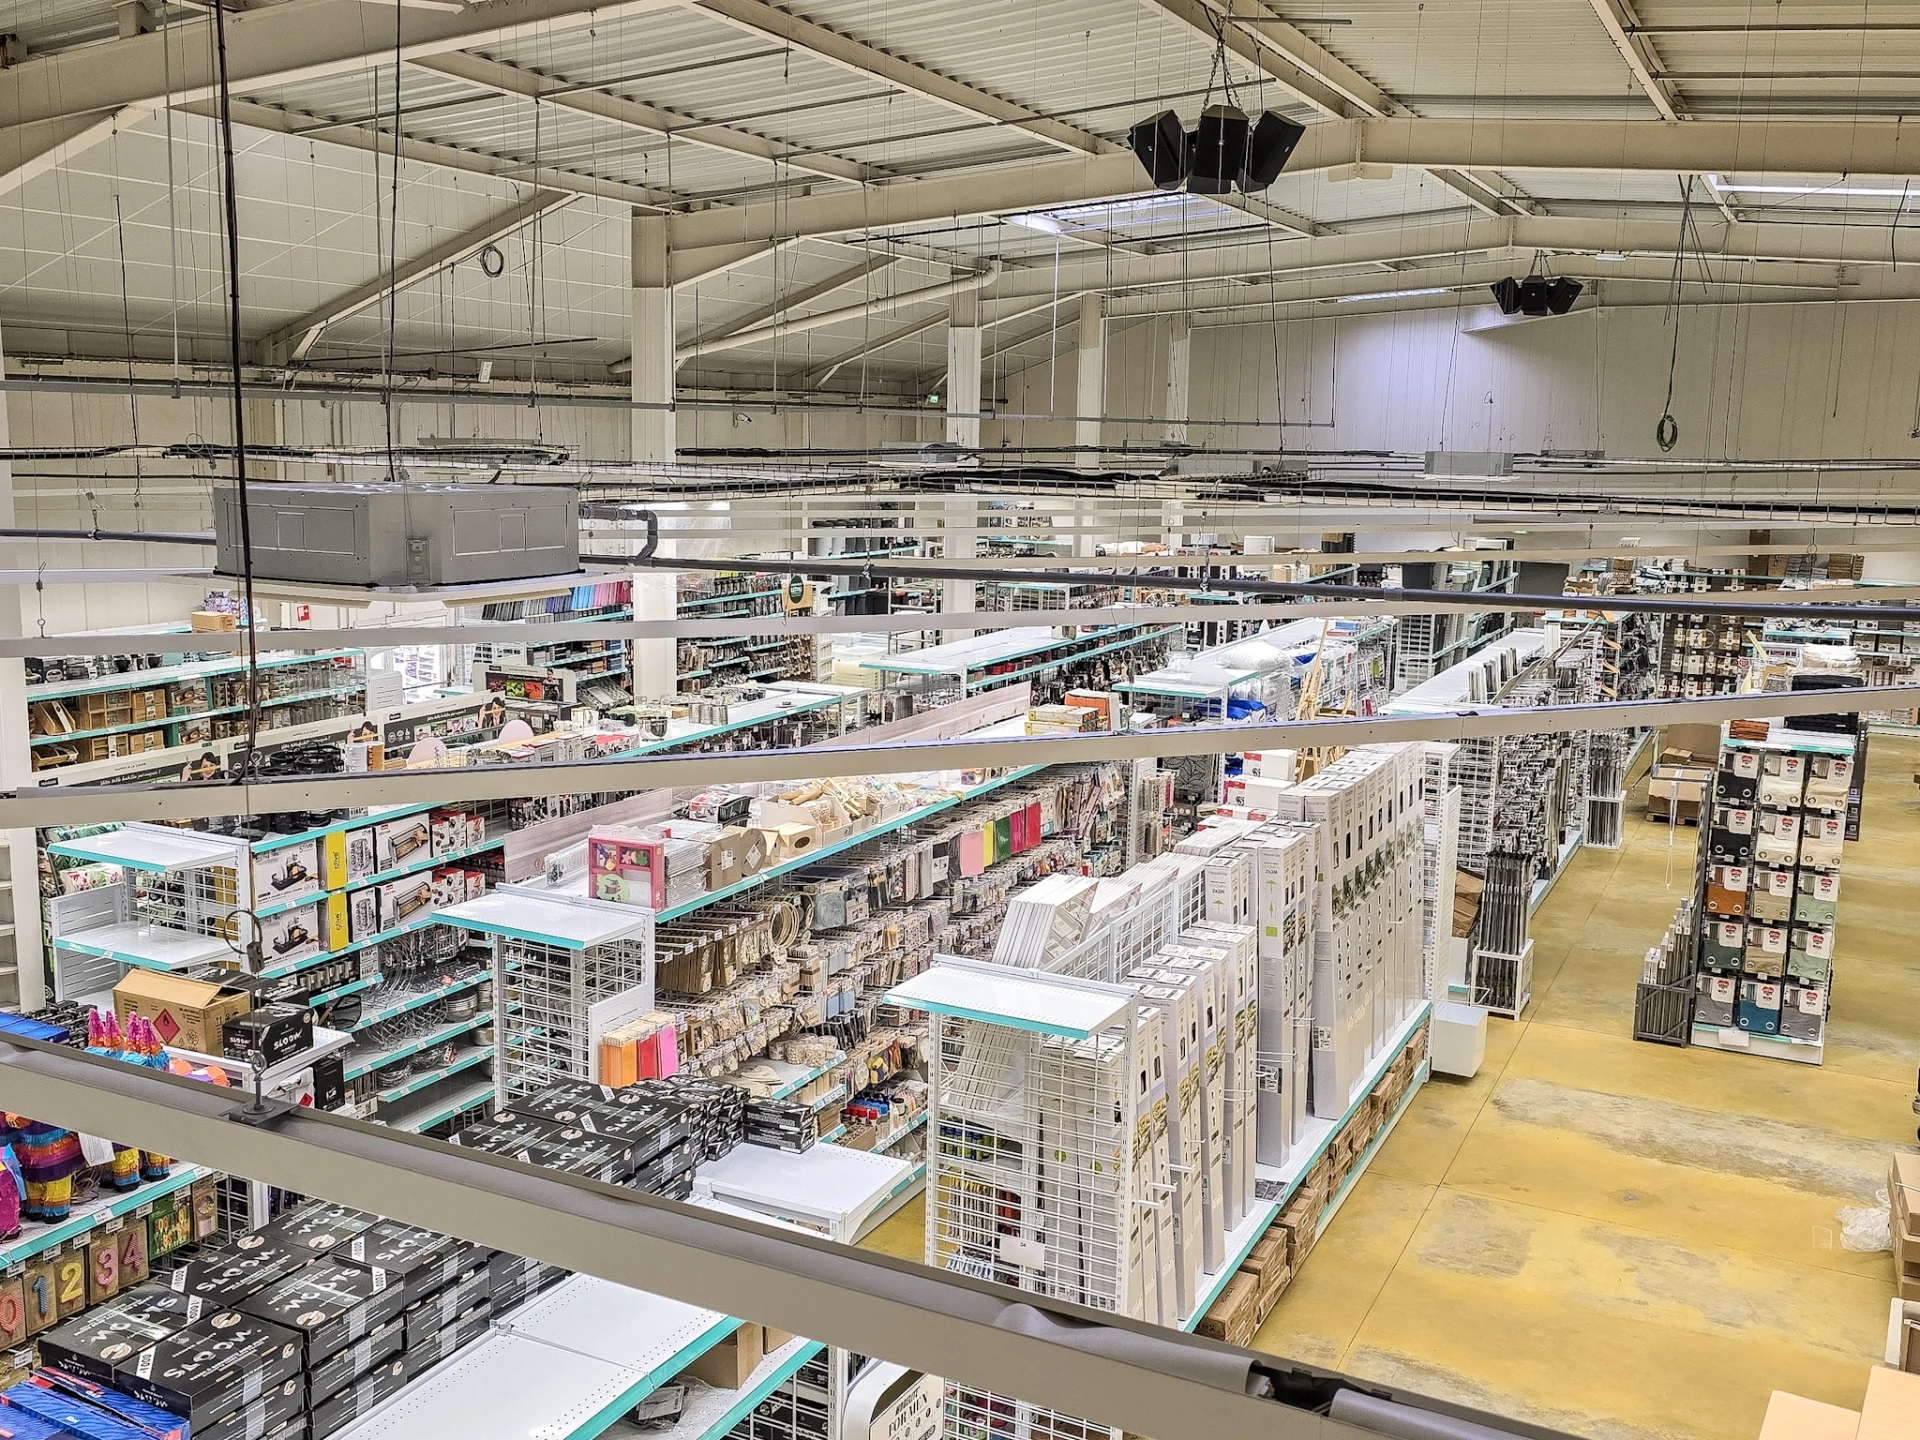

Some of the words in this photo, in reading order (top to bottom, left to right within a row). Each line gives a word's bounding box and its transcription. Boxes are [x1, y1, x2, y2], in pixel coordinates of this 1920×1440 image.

[96, 1248, 118, 1286] 3
[123, 1232, 143, 1271] 4
[32, 1275, 47, 1315] 1
[61, 1262, 83, 1303] 2
[0, 1293, 21, 1334] 0
[888, 1411, 907, 1437] FOR
[908, 1391, 928, 1416] MEN
